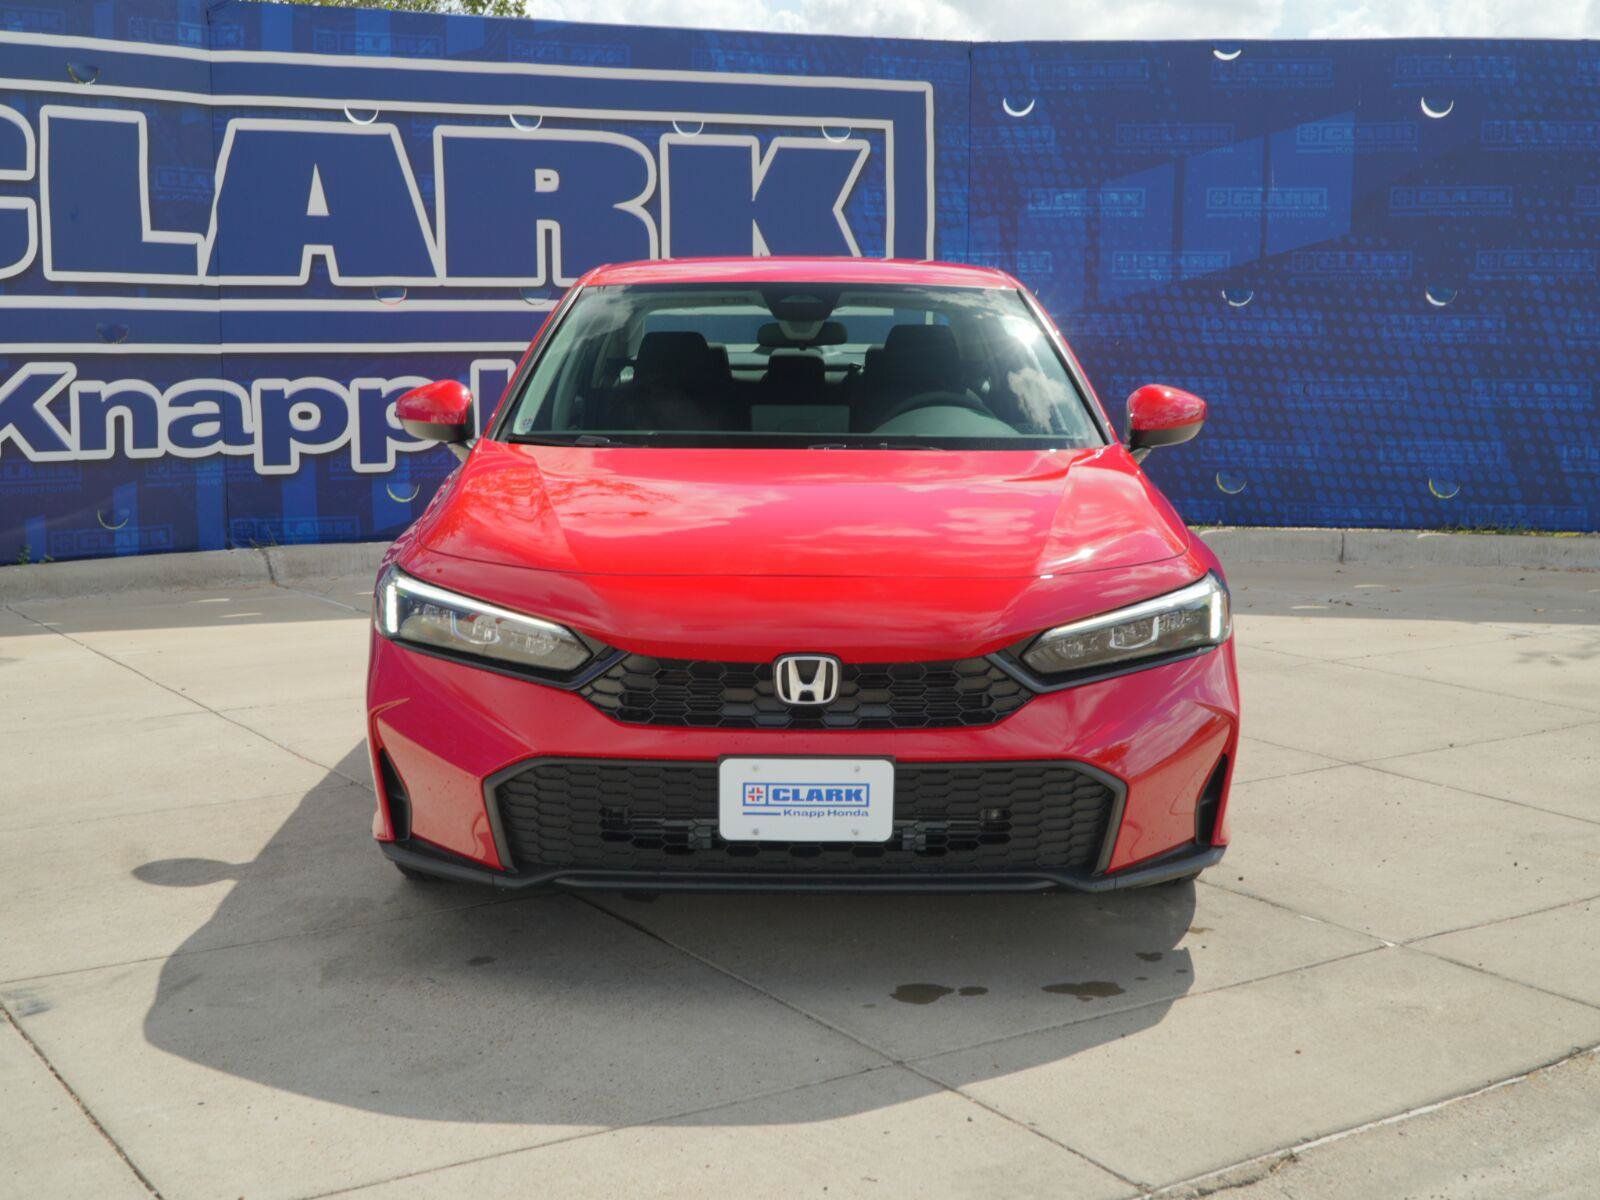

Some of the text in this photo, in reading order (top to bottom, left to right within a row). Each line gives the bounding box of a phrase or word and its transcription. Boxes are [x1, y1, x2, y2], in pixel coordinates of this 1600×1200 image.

[0, 103, 870, 286] LARK
[772, 788, 863, 802] CLARK
[783, 808, 869, 817] Knapp Honda
